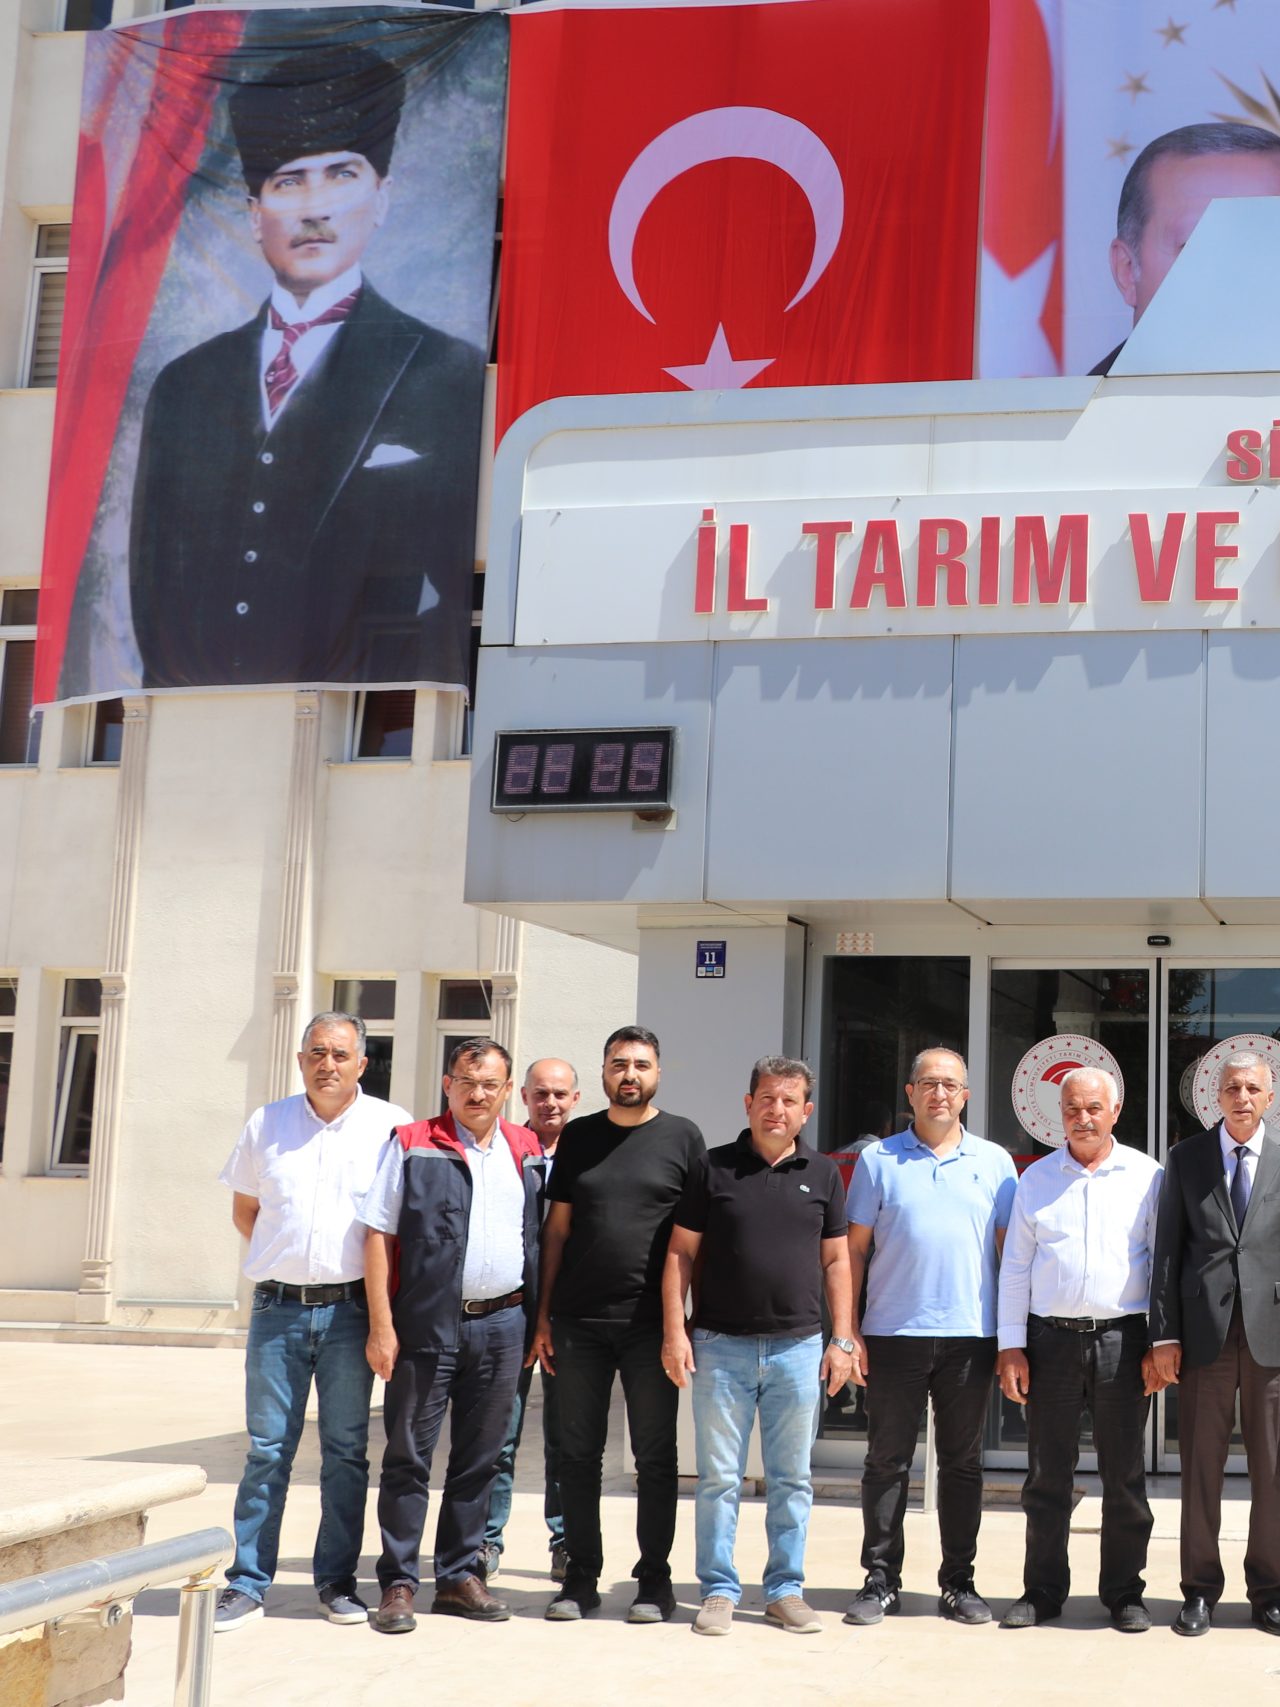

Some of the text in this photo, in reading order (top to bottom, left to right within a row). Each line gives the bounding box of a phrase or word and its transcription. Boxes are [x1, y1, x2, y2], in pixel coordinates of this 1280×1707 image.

[694, 508, 769, 614] İL
[802, 514, 1089, 609] TARIM
[1128, 511, 1240, 602] VE
[704, 951, 717, 965] 11
